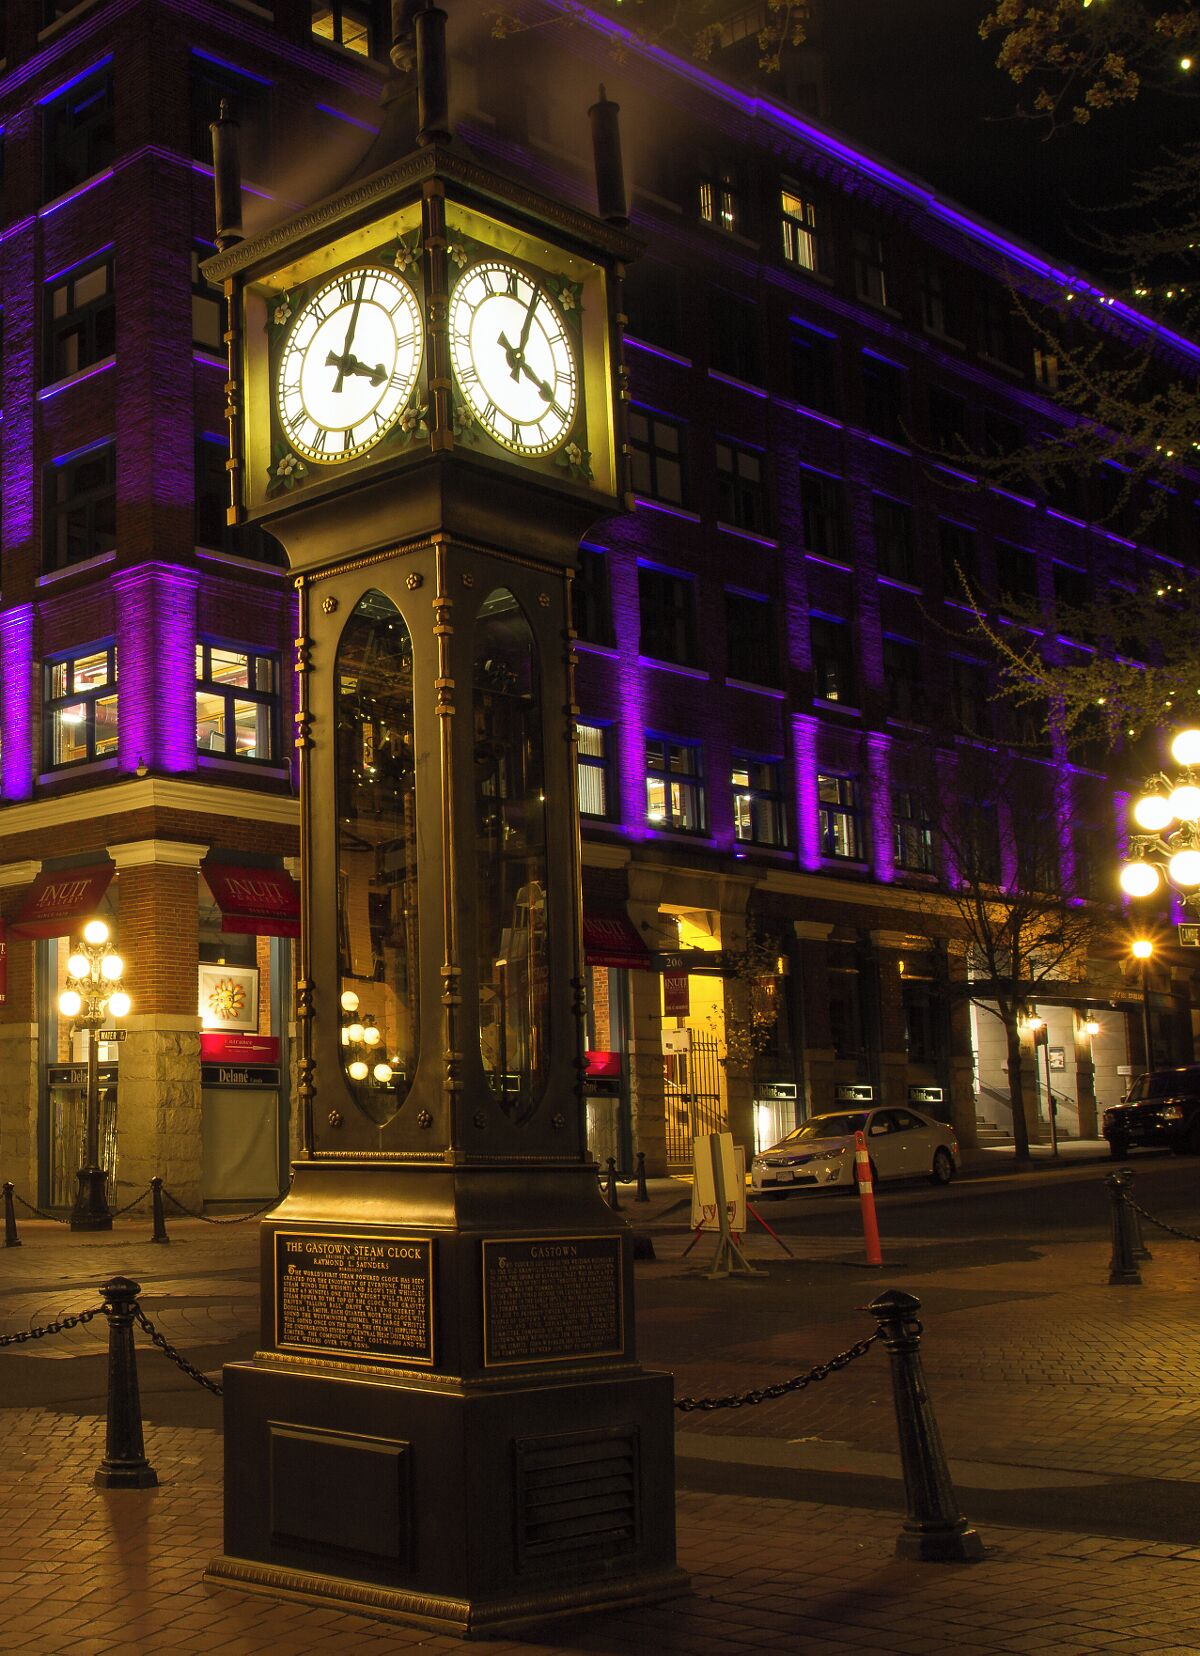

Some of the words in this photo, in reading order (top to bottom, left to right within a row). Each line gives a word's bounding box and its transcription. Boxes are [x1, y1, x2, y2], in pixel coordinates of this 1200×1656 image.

[39, 879, 92, 902] INUIT
[224, 878, 284, 899] INUIT
[666, 958, 682, 967] 206
[101, 1032, 116, 1040] WATER
[219, 1068, 248, 1082] Delané
[286, 1242, 302, 1252] THE
[305, 1243, 350, 1254] GASTOWN
[354, 1245, 383, 1256] STEAM
[387, 1247, 421, 1258] CLOCK
[530, 1244, 576, 1258] GASTOWN
[313, 1258, 344, 1266] RAYMOND
[356, 1260, 388, 1269] SAUNDERS
